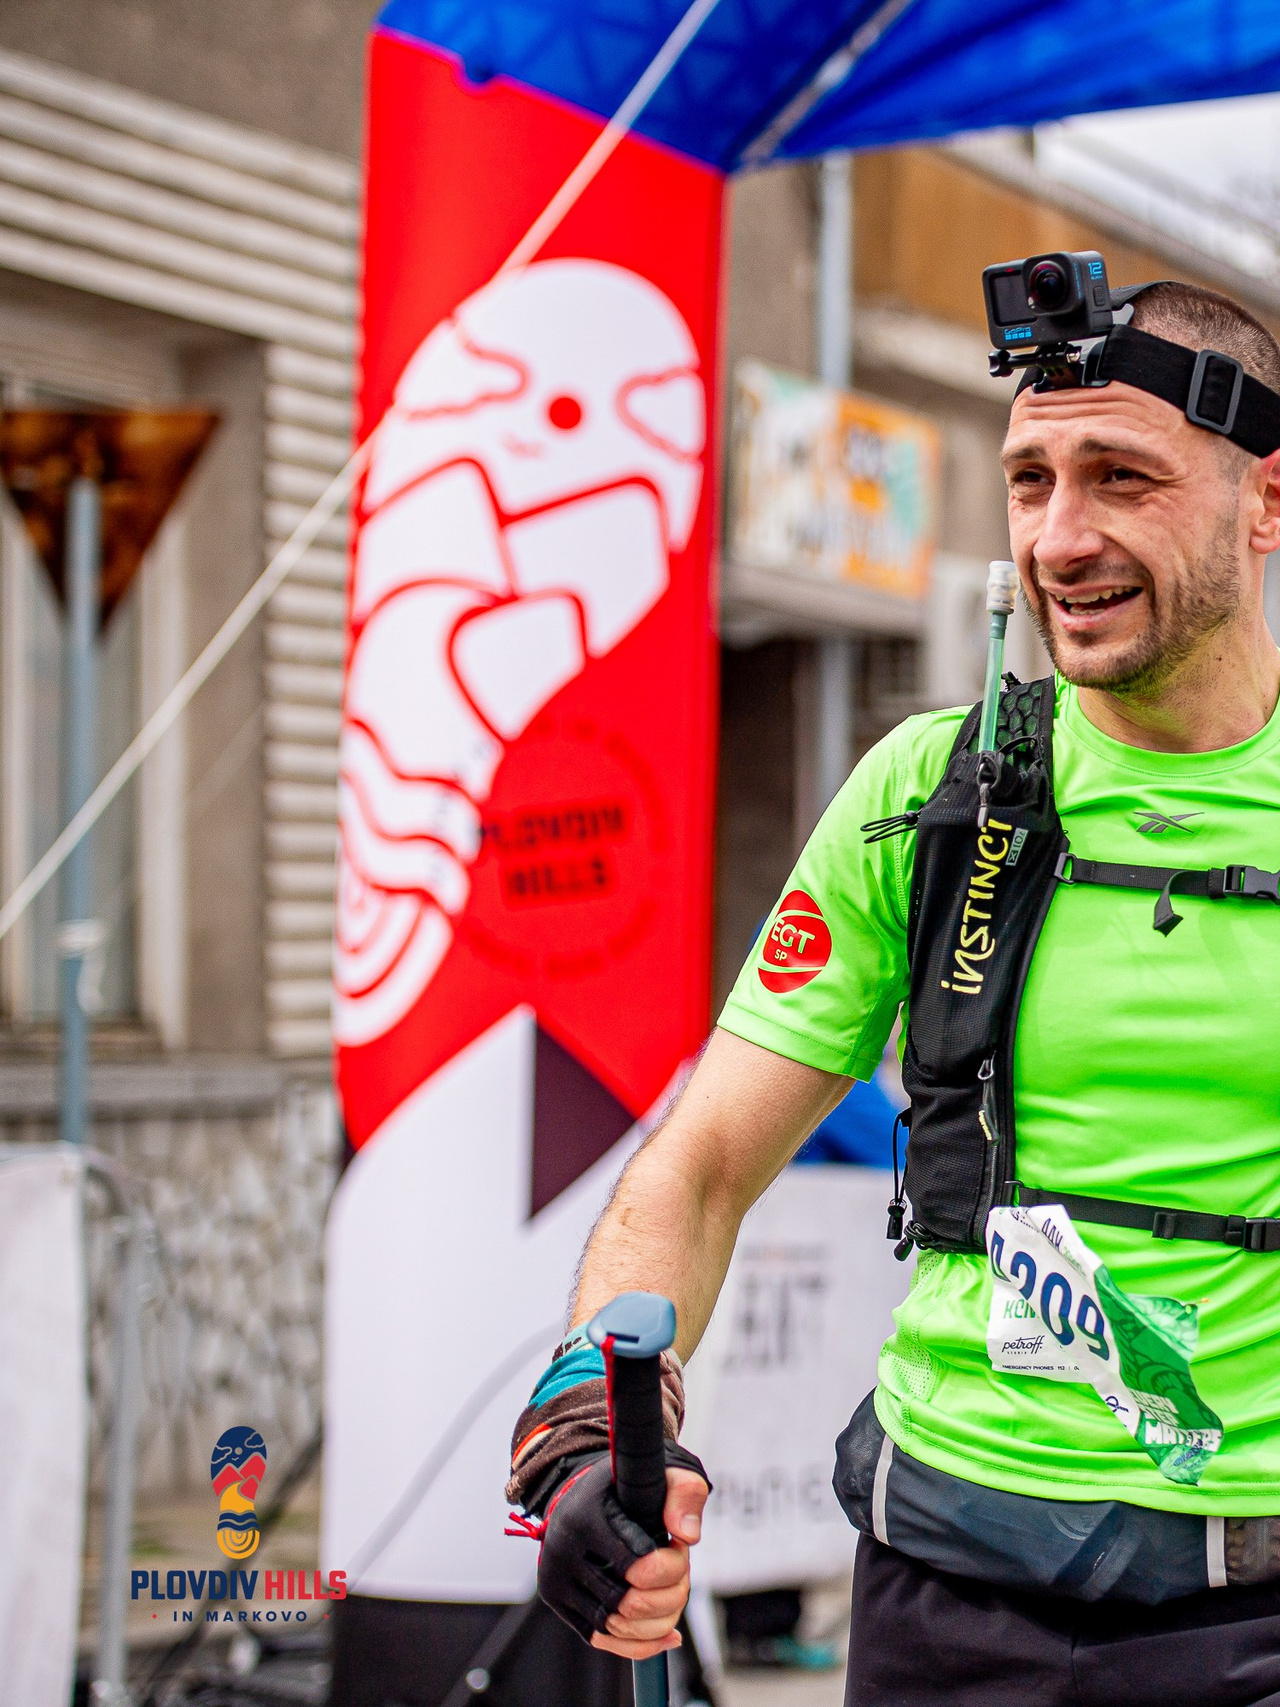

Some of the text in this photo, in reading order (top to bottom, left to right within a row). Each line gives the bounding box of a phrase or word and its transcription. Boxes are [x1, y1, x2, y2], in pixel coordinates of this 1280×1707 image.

[1088, 261, 1103, 275] 12
[1004, 326, 1031, 335] GoPro
[771, 917, 815, 954] EGT
